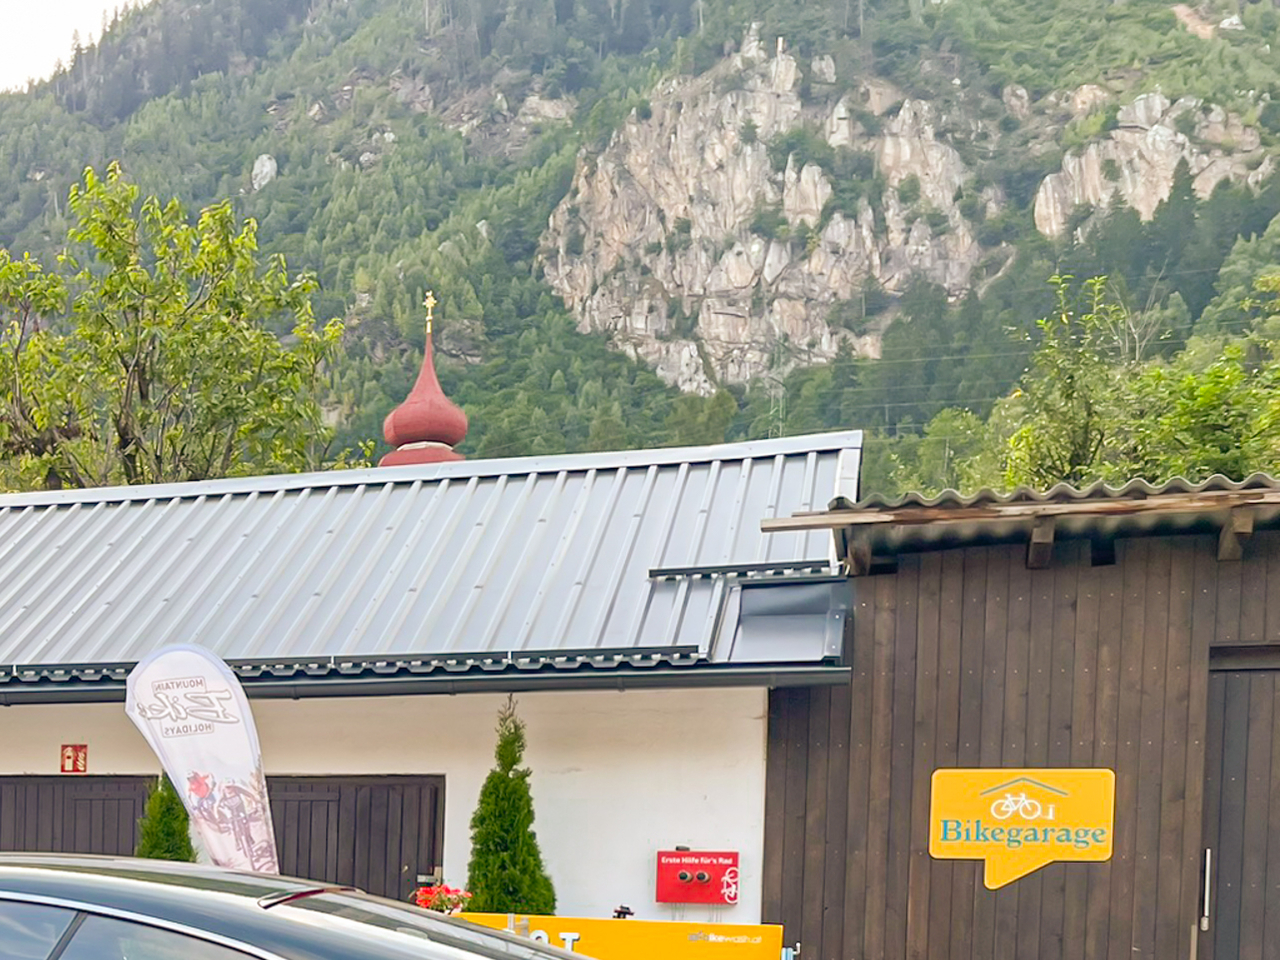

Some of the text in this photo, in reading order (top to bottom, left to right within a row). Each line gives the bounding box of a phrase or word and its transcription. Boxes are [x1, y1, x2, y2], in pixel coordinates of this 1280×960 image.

[940, 819, 1107, 849] Bikegarage
[661, 856, 680, 864] Erste
[682, 857, 699, 865] Hilfe
[719, 857, 733, 865] Rad
